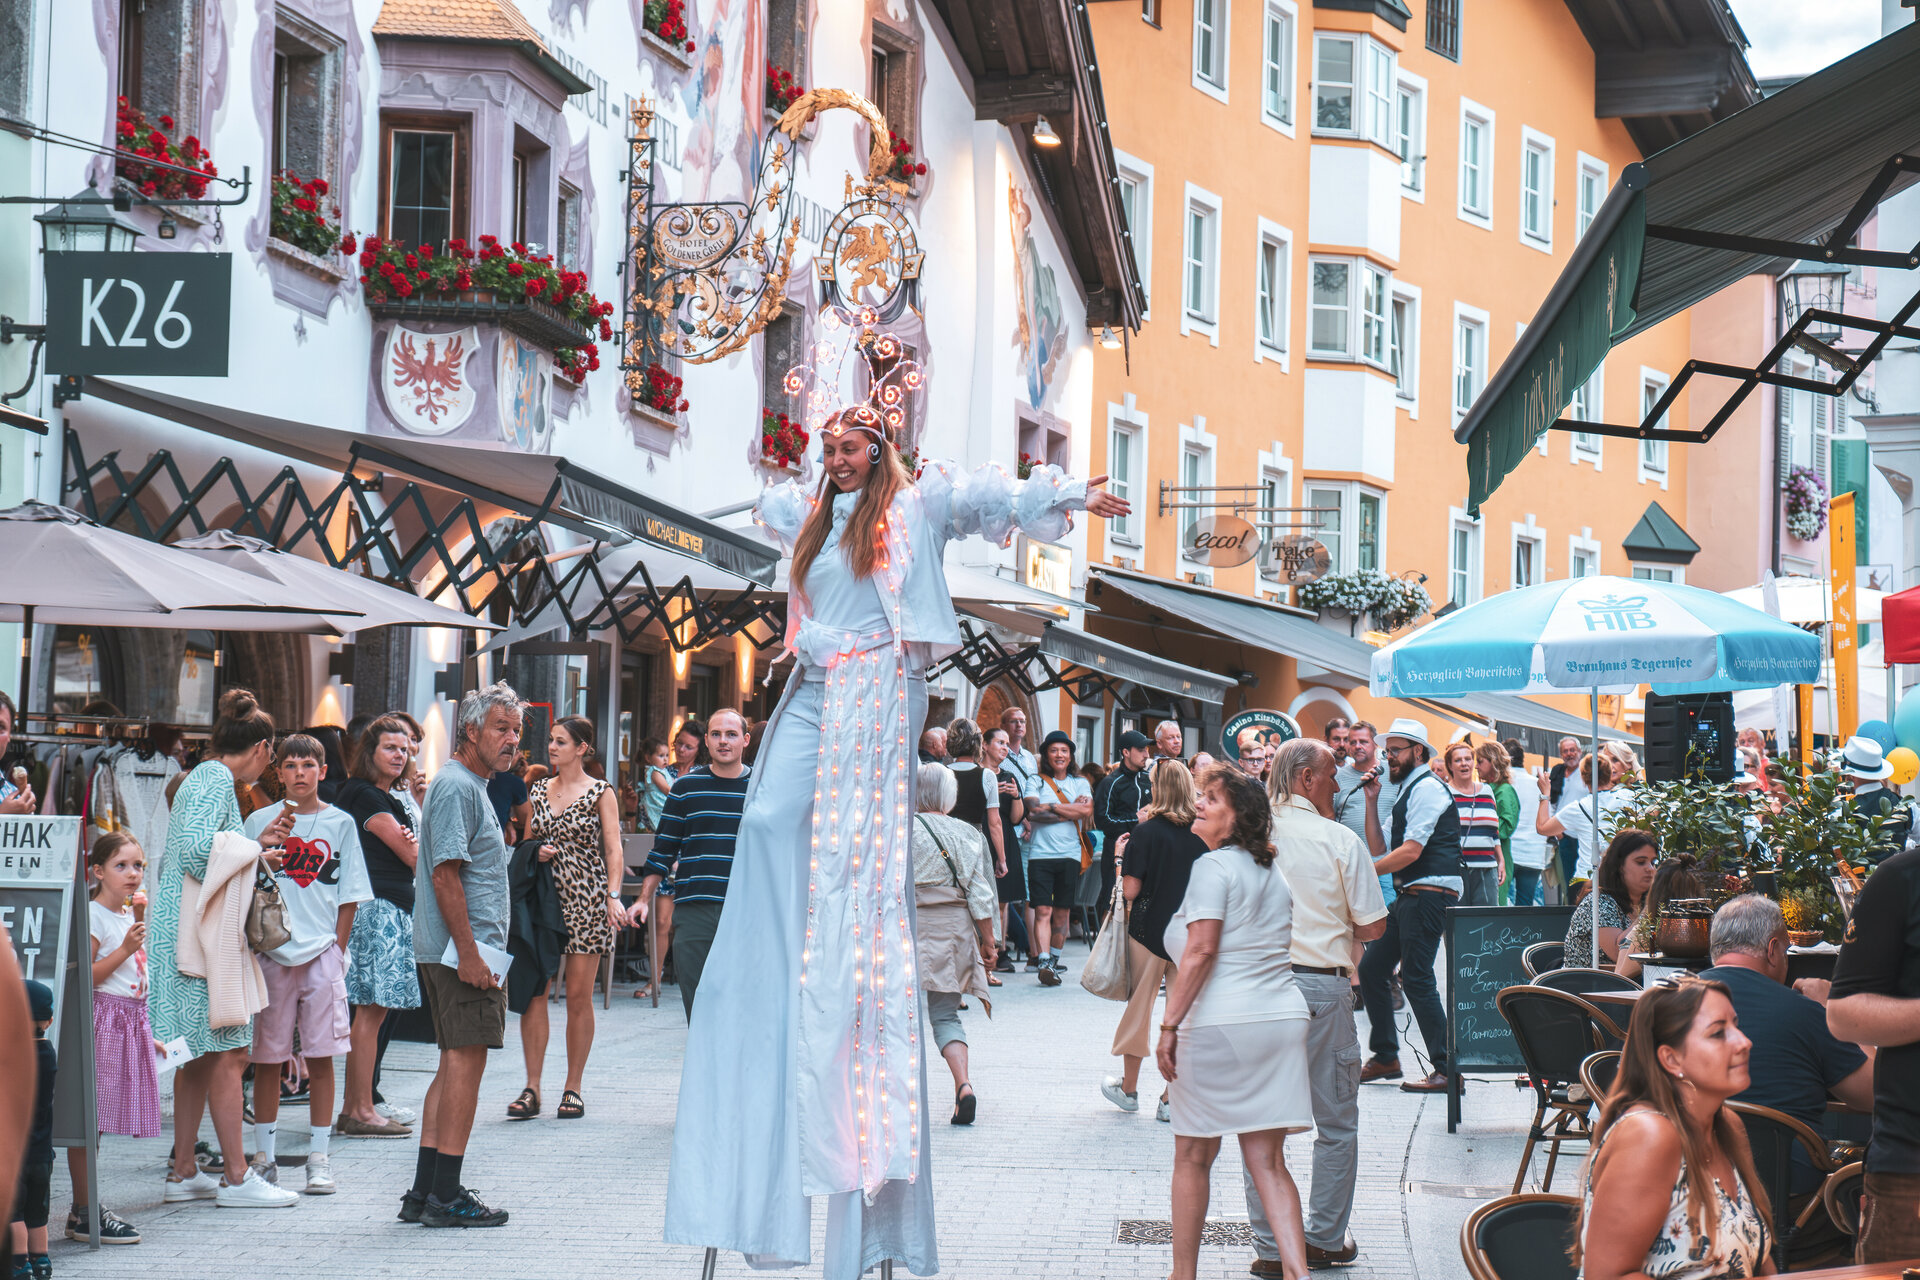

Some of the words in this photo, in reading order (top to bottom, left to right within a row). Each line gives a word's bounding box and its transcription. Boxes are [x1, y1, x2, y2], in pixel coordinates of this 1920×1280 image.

[663, 238, 703, 261] GOLDENER
[702, 238, 726, 258] GREIF
[679, 239, 709, 248] HOTEL
[81, 277, 193, 349] K26
[1194, 530, 1249, 550] ecco!
[1272, 546, 1315, 560] Take
[1583, 610, 1657, 632] HTB
[1406, 668, 1462, 684] Herzoglich
[1565, 659, 1628, 674] Brauhaus
[1226, 715, 1253, 737] Casino
[1253, 713, 1293, 736] Kitzbühel
[0, 822, 54, 849] HAK
[1459, 957, 1480, 978] mit
[1457, 1001, 1477, 1011] aus
